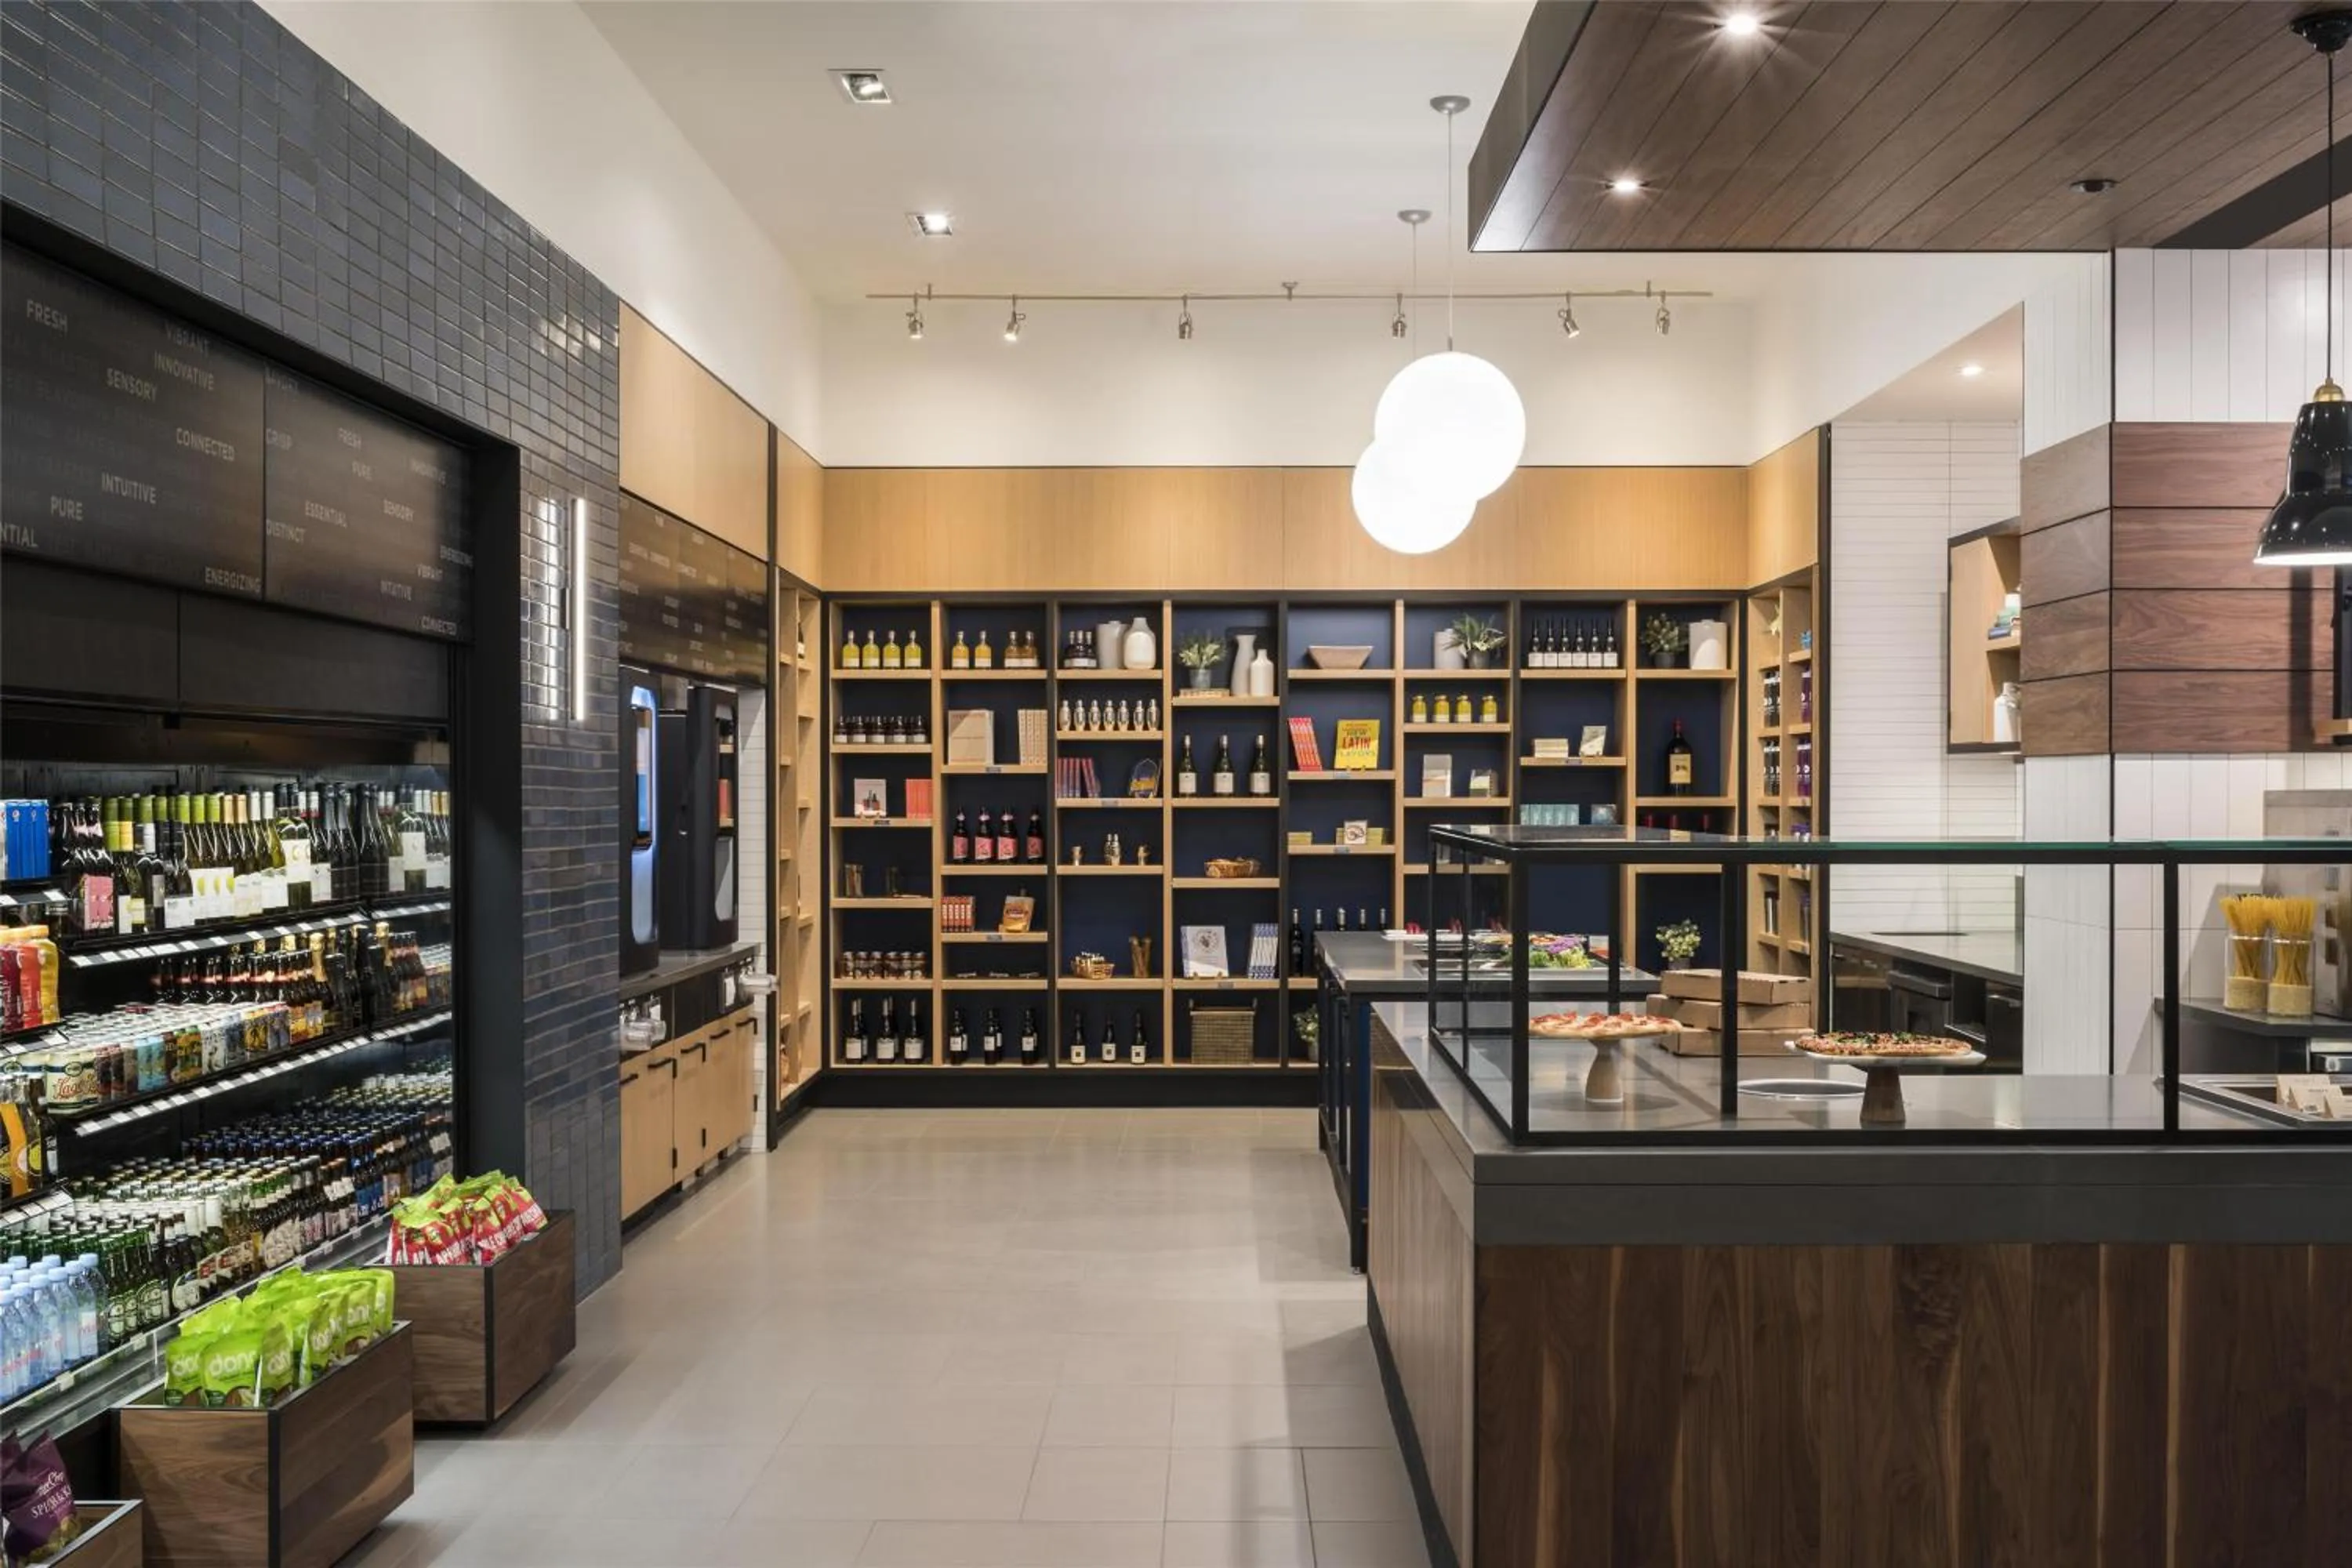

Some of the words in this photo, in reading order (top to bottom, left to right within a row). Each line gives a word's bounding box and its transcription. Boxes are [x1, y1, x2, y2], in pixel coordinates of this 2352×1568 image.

[26, 298, 68, 334] FRESH
[106, 367, 157, 402] SENSORY
[154, 350, 215, 391] INNOVATIVE
[176, 427, 235, 463] CONNECTED
[101, 472, 157, 505] INTUITIVE
[50, 495, 83, 521] PURE
[205, 565, 262, 593] ENERGIZING
[1341, 736, 1371, 750] LATIN
